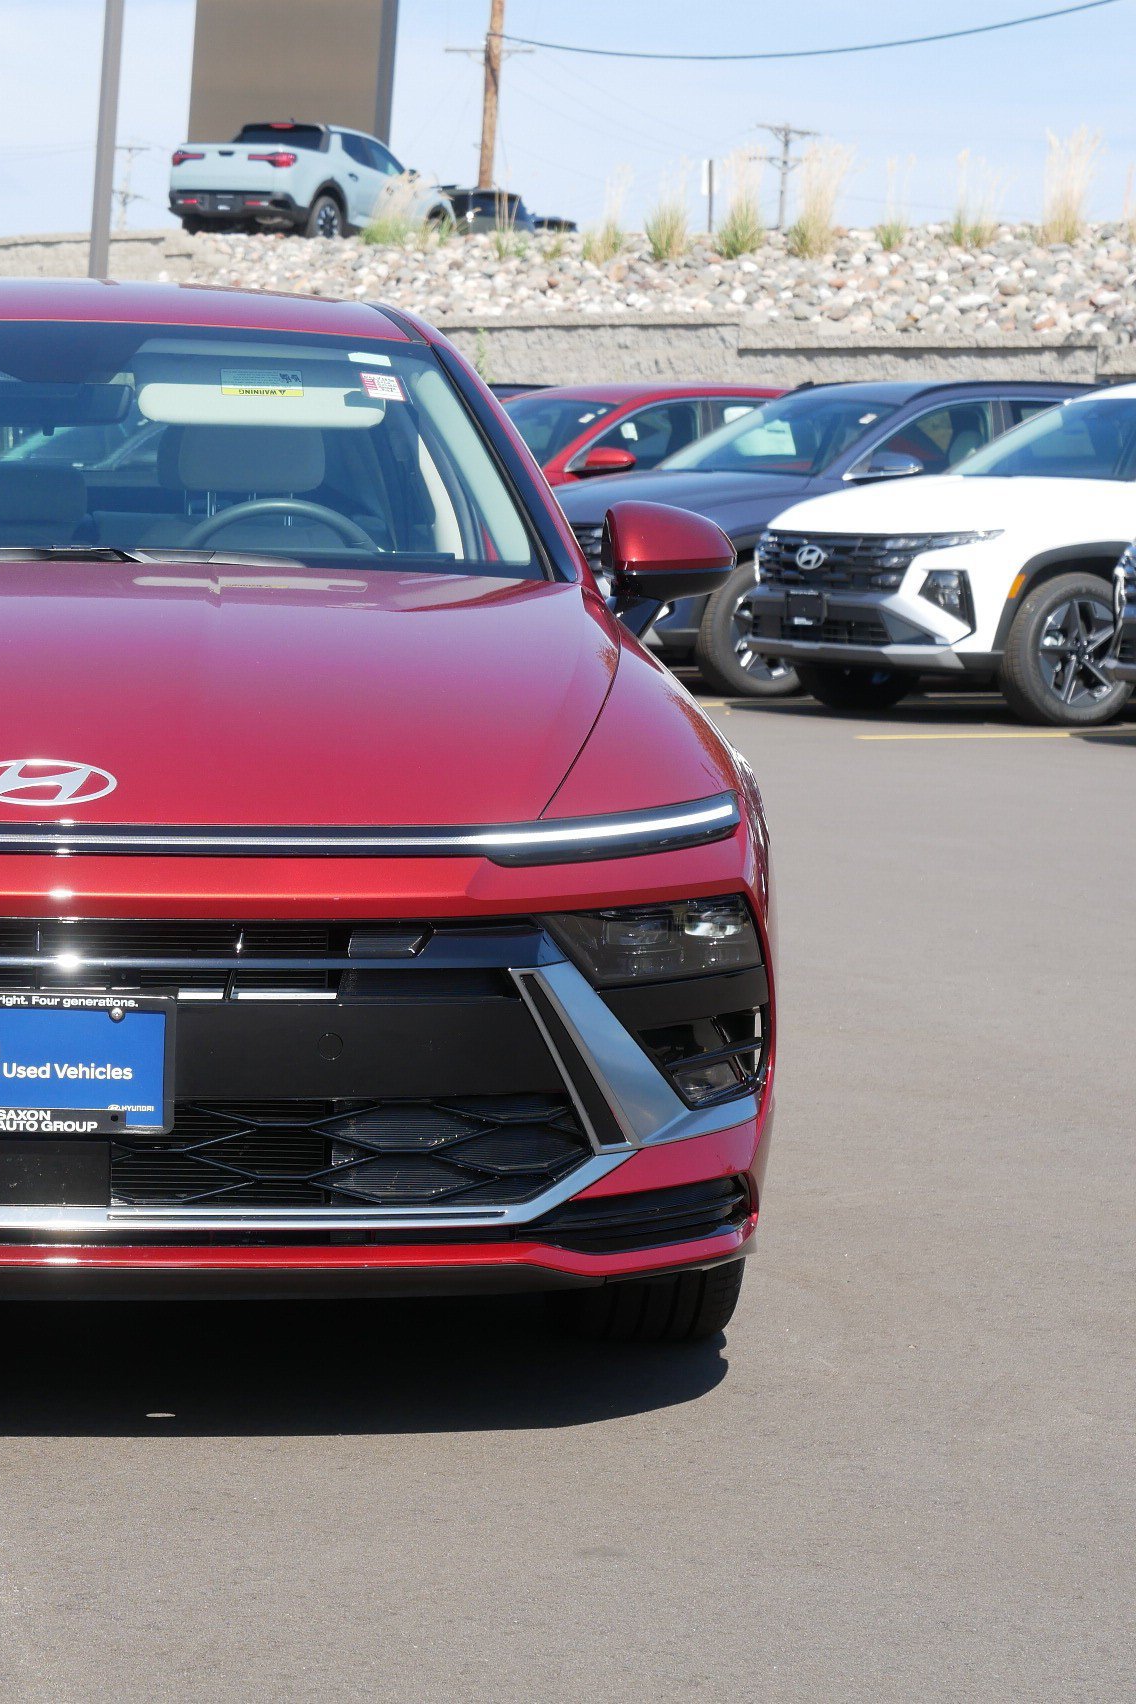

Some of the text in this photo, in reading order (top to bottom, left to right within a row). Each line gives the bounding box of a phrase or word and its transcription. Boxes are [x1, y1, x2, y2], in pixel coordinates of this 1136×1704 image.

[31, 996, 61, 1006] Four
[63, 996, 139, 1008] generations.
[2, 1062, 51, 1079] Used
[54, 1063, 133, 1080] Vehicles
[121, 1104, 155, 1112] HYUNDAI
[31, 1120, 98, 1132] GROUP
